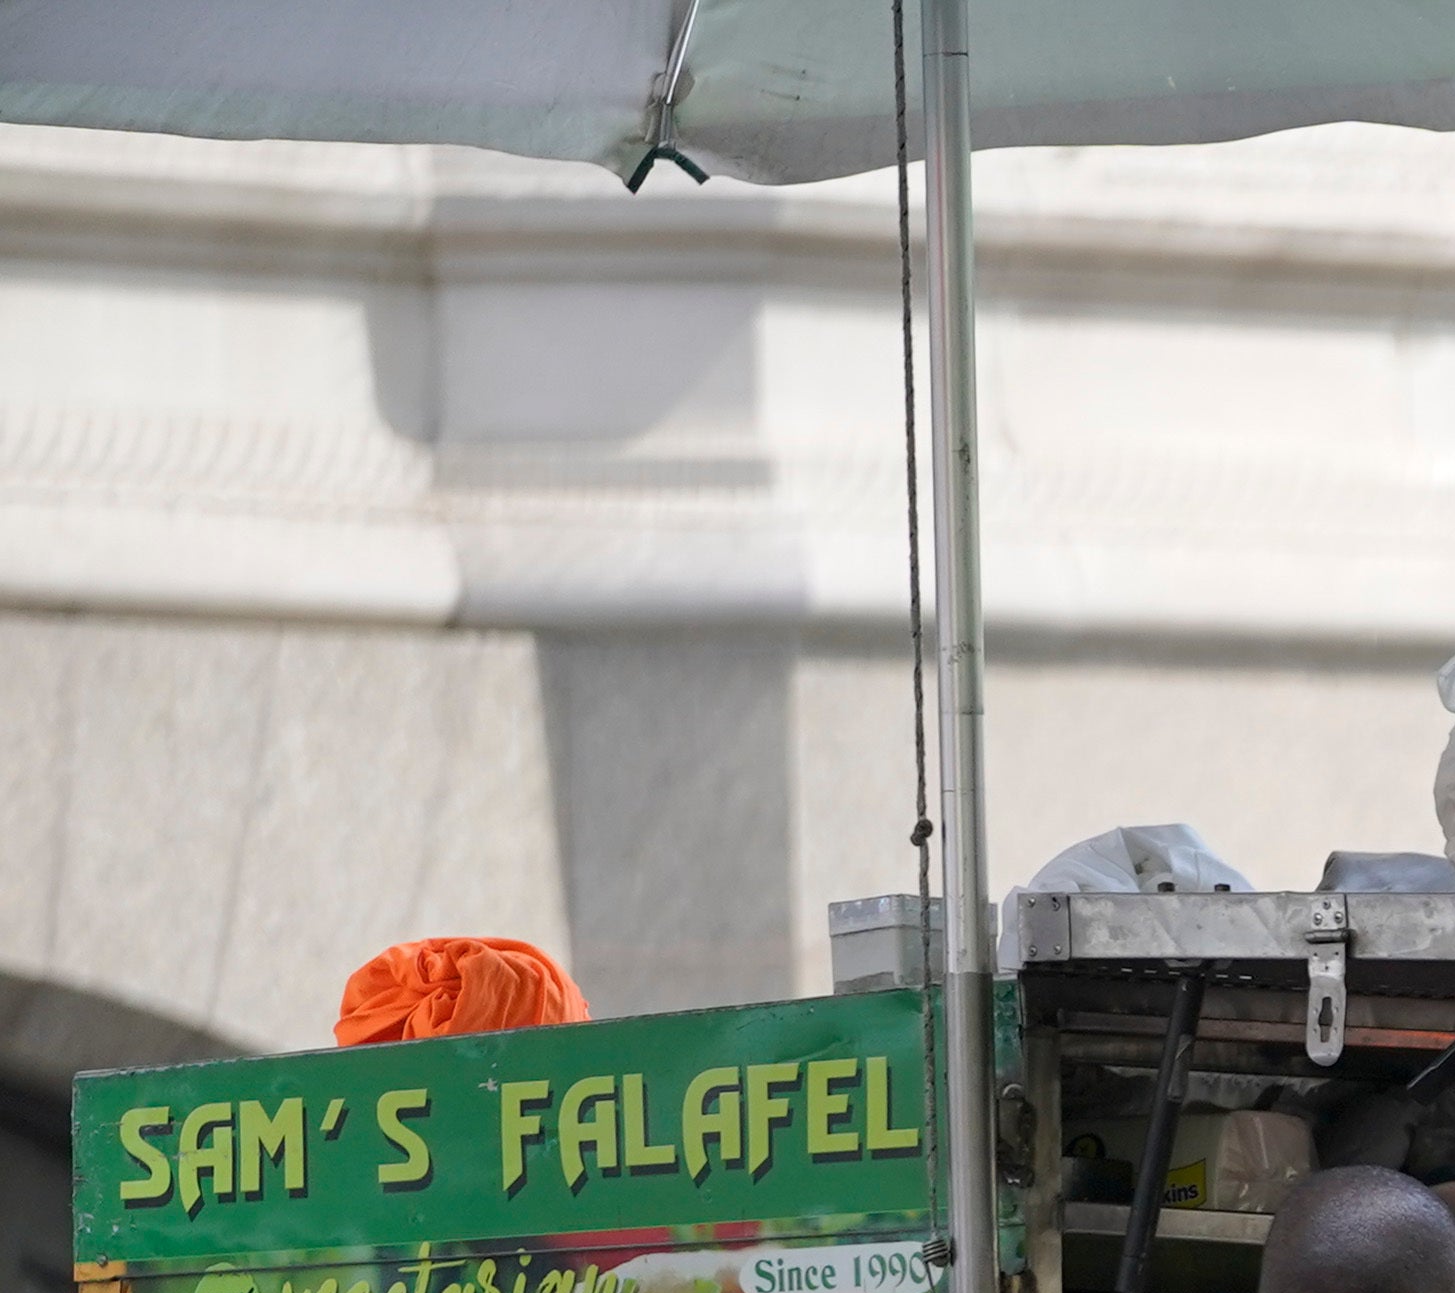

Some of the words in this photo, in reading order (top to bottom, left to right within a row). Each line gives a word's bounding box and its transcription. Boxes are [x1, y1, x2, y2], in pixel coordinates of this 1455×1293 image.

[500, 1056, 924, 1194] FALAFEL
[754, 1258, 838, 1293] Since
[853, 1252, 929, 1288] 1990
